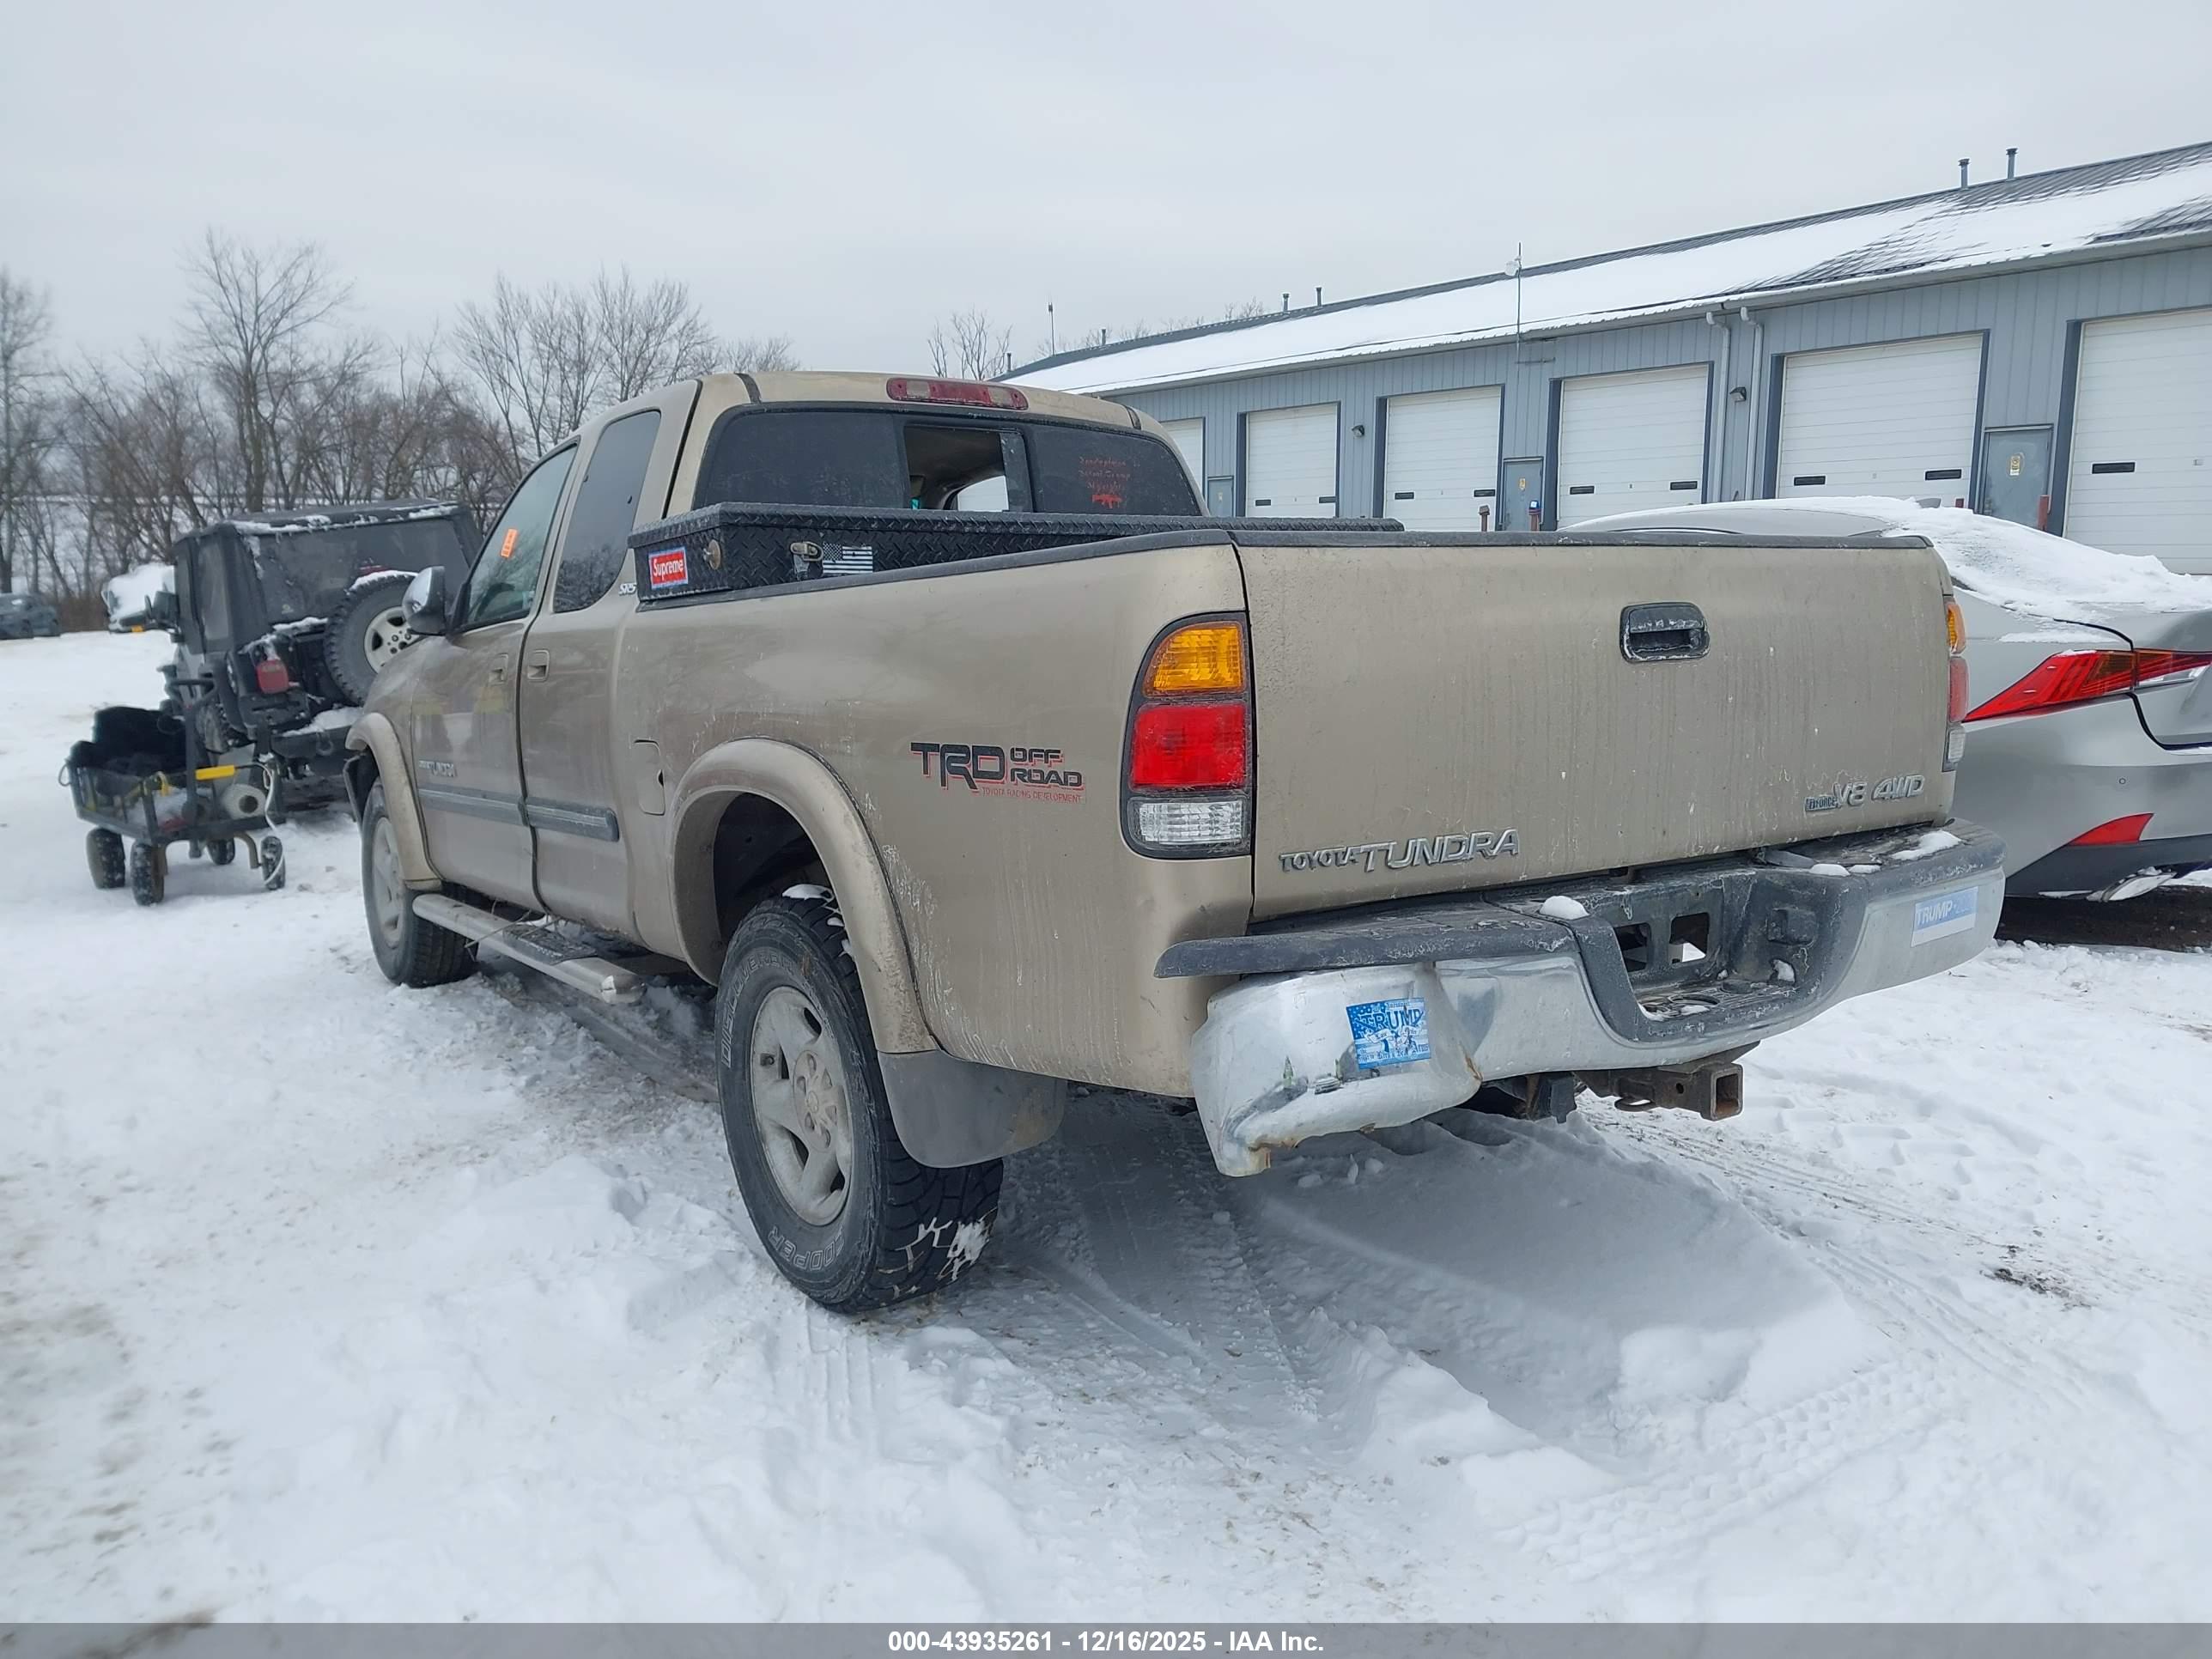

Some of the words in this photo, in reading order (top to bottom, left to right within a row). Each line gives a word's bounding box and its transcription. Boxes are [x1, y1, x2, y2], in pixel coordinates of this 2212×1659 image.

[653, 558, 684, 581] Supreme
[911, 742, 1006, 792] TRD
[1010, 747, 1063, 766] OFF
[1010, 768, 1085, 790] ROAD
[1832, 782, 1868, 807] V8
[1871, 775, 1925, 800] 4WD
[1279, 846, 1361, 872] TOYOTA
[1360, 827, 1520, 873] TUNDRA
[1917, 899, 1954, 925] TRUMP
[1358, 1008, 1422, 1030] TRUMP
[768, 1225, 845, 1271] COOPER
